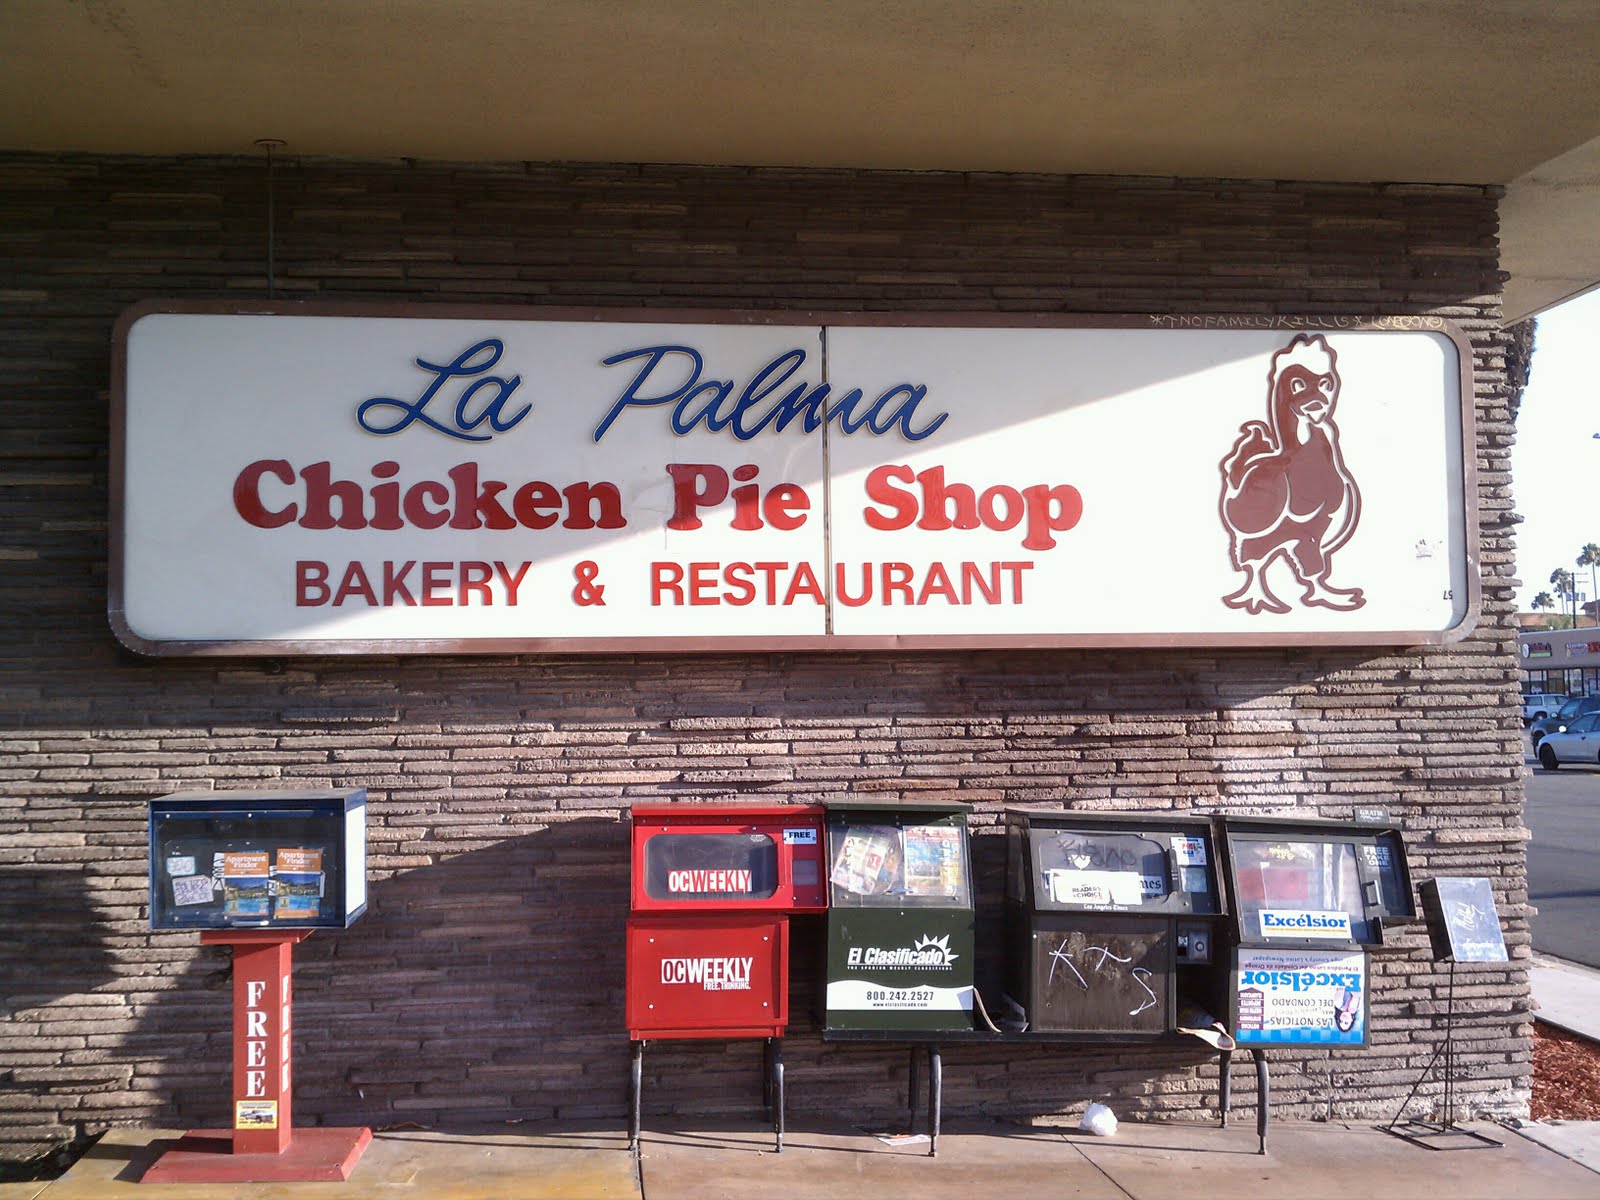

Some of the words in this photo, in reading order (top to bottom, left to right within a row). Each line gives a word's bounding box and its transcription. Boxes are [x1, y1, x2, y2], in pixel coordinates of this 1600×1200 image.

[356, 338, 532, 441] La
[594, 345, 949, 443] Palma
[233, 458, 627, 530] Chicken
[666, 463, 810, 531] Pie
[864, 464, 1083, 550] Shop
[296, 561, 532, 607] BAKERY
[571, 561, 606, 606] &
[650, 561, 1035, 606] RESTAURANT
[788, 831, 811, 839] FREE
[1363, 846, 1388, 855] FREE
[226, 855, 266, 863] Apartment
[279, 851, 319, 860] Apartment
[1263, 914, 1347, 927] Excélsior
[848, 947, 862, 964] El
[864, 946, 944, 965] Clasificado
[1241, 971, 1361, 991] Excélsior
[866, 991, 934, 1001] 800.242.2527
[1272, 998, 1315, 1006] CONDADO
[1318, 999, 1333, 1007] DEL
[1270, 1017, 1313, 1026] NOTICIAS
[1317, 1018, 1333, 1026] LAS
